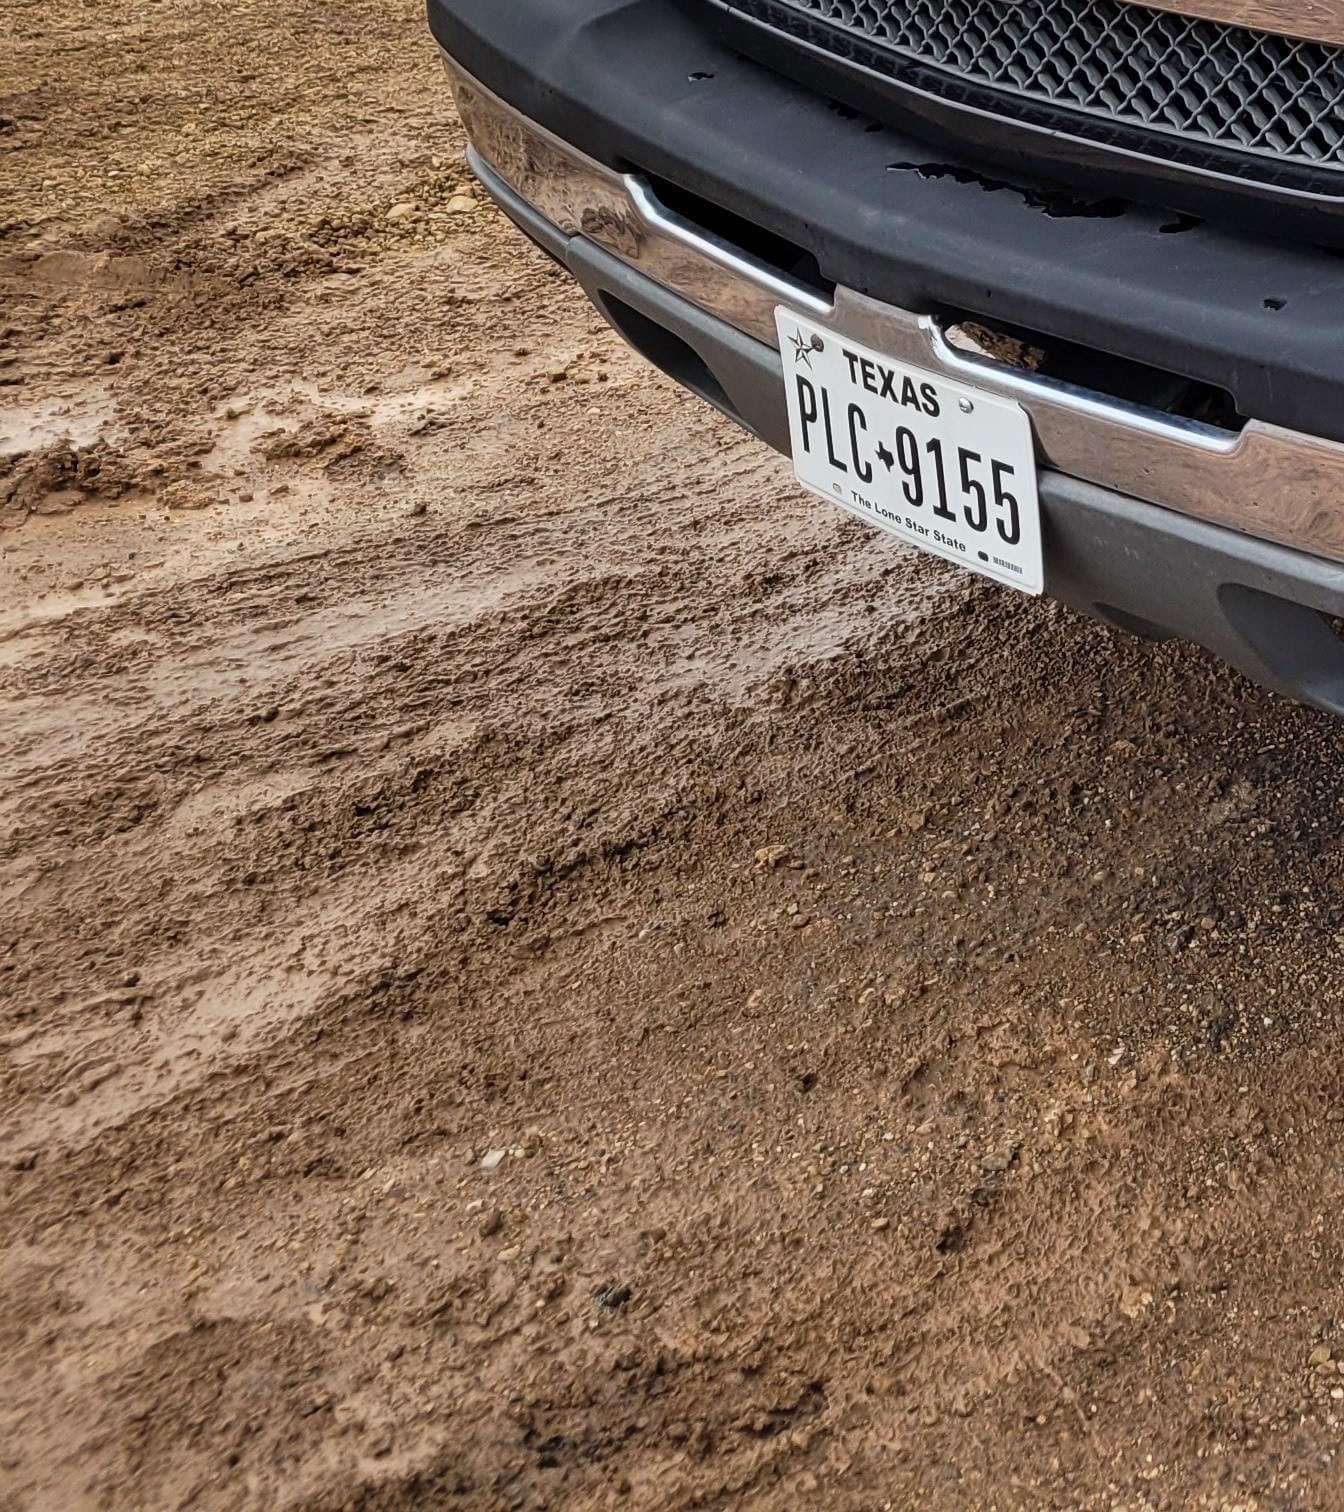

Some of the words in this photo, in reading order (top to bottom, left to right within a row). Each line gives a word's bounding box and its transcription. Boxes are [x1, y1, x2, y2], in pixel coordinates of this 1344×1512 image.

[842, 348, 941, 418] TEXAS
[851, 490, 872, 509] The
[874, 502, 902, 524] Lone
[905, 517, 930, 536] Star
[933, 529, 966, 552] State
